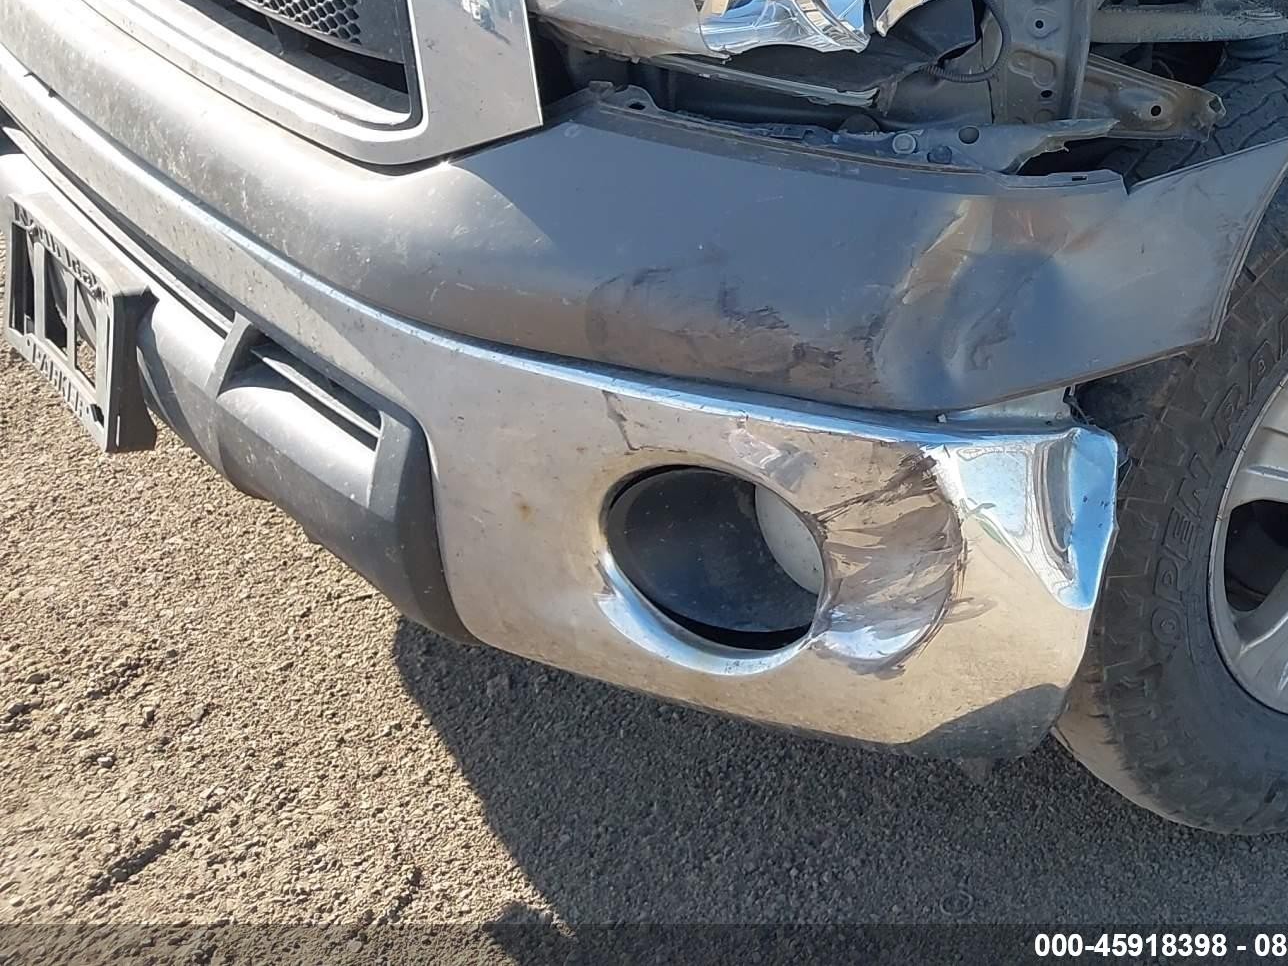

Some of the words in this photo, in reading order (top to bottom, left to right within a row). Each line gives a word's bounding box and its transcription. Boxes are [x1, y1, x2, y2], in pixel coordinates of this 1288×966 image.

[13, 200, 61, 258] Nrth
[31, 340, 84, 419] PARKER
[1151, 452, 1215, 640] OPEN
